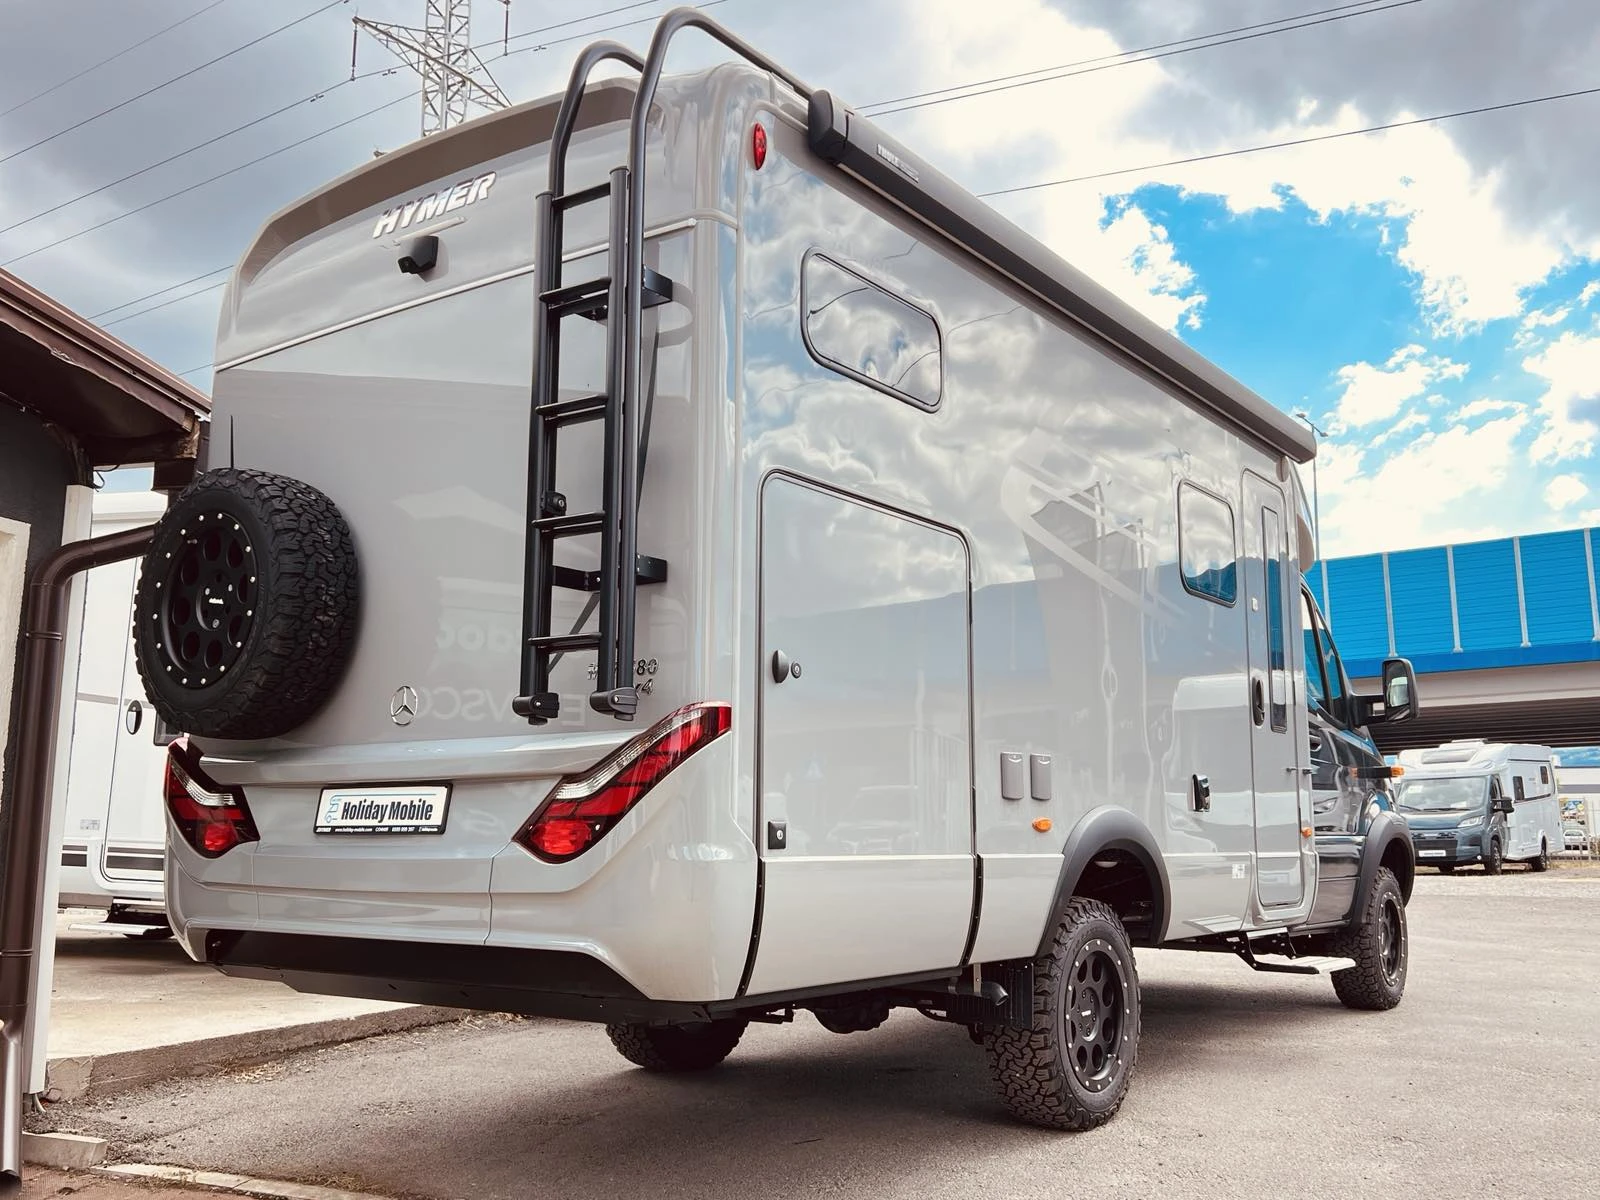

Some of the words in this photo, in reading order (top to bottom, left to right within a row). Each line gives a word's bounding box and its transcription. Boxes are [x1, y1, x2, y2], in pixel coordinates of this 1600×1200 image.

[372, 171, 497, 239] HYMER
[341, 799, 388, 823] Holiday
[388, 798, 433, 820] Mobile
